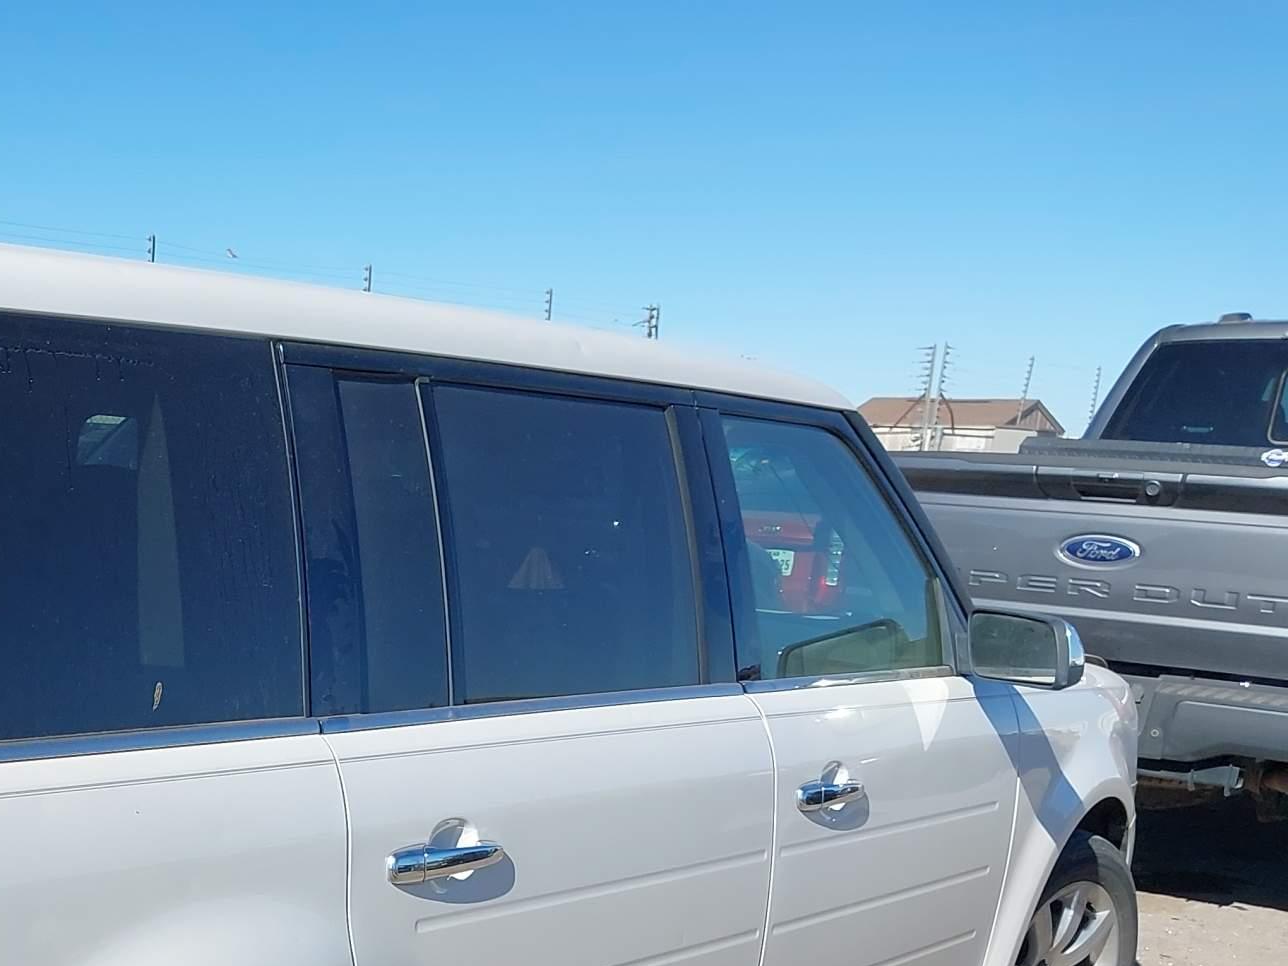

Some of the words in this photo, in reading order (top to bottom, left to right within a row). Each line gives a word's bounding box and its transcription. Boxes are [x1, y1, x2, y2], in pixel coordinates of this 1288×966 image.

[1076, 540, 1121, 559] Ford
[968, 568, 1111, 598] PER
[1133, 583, 1288, 614] DUT
